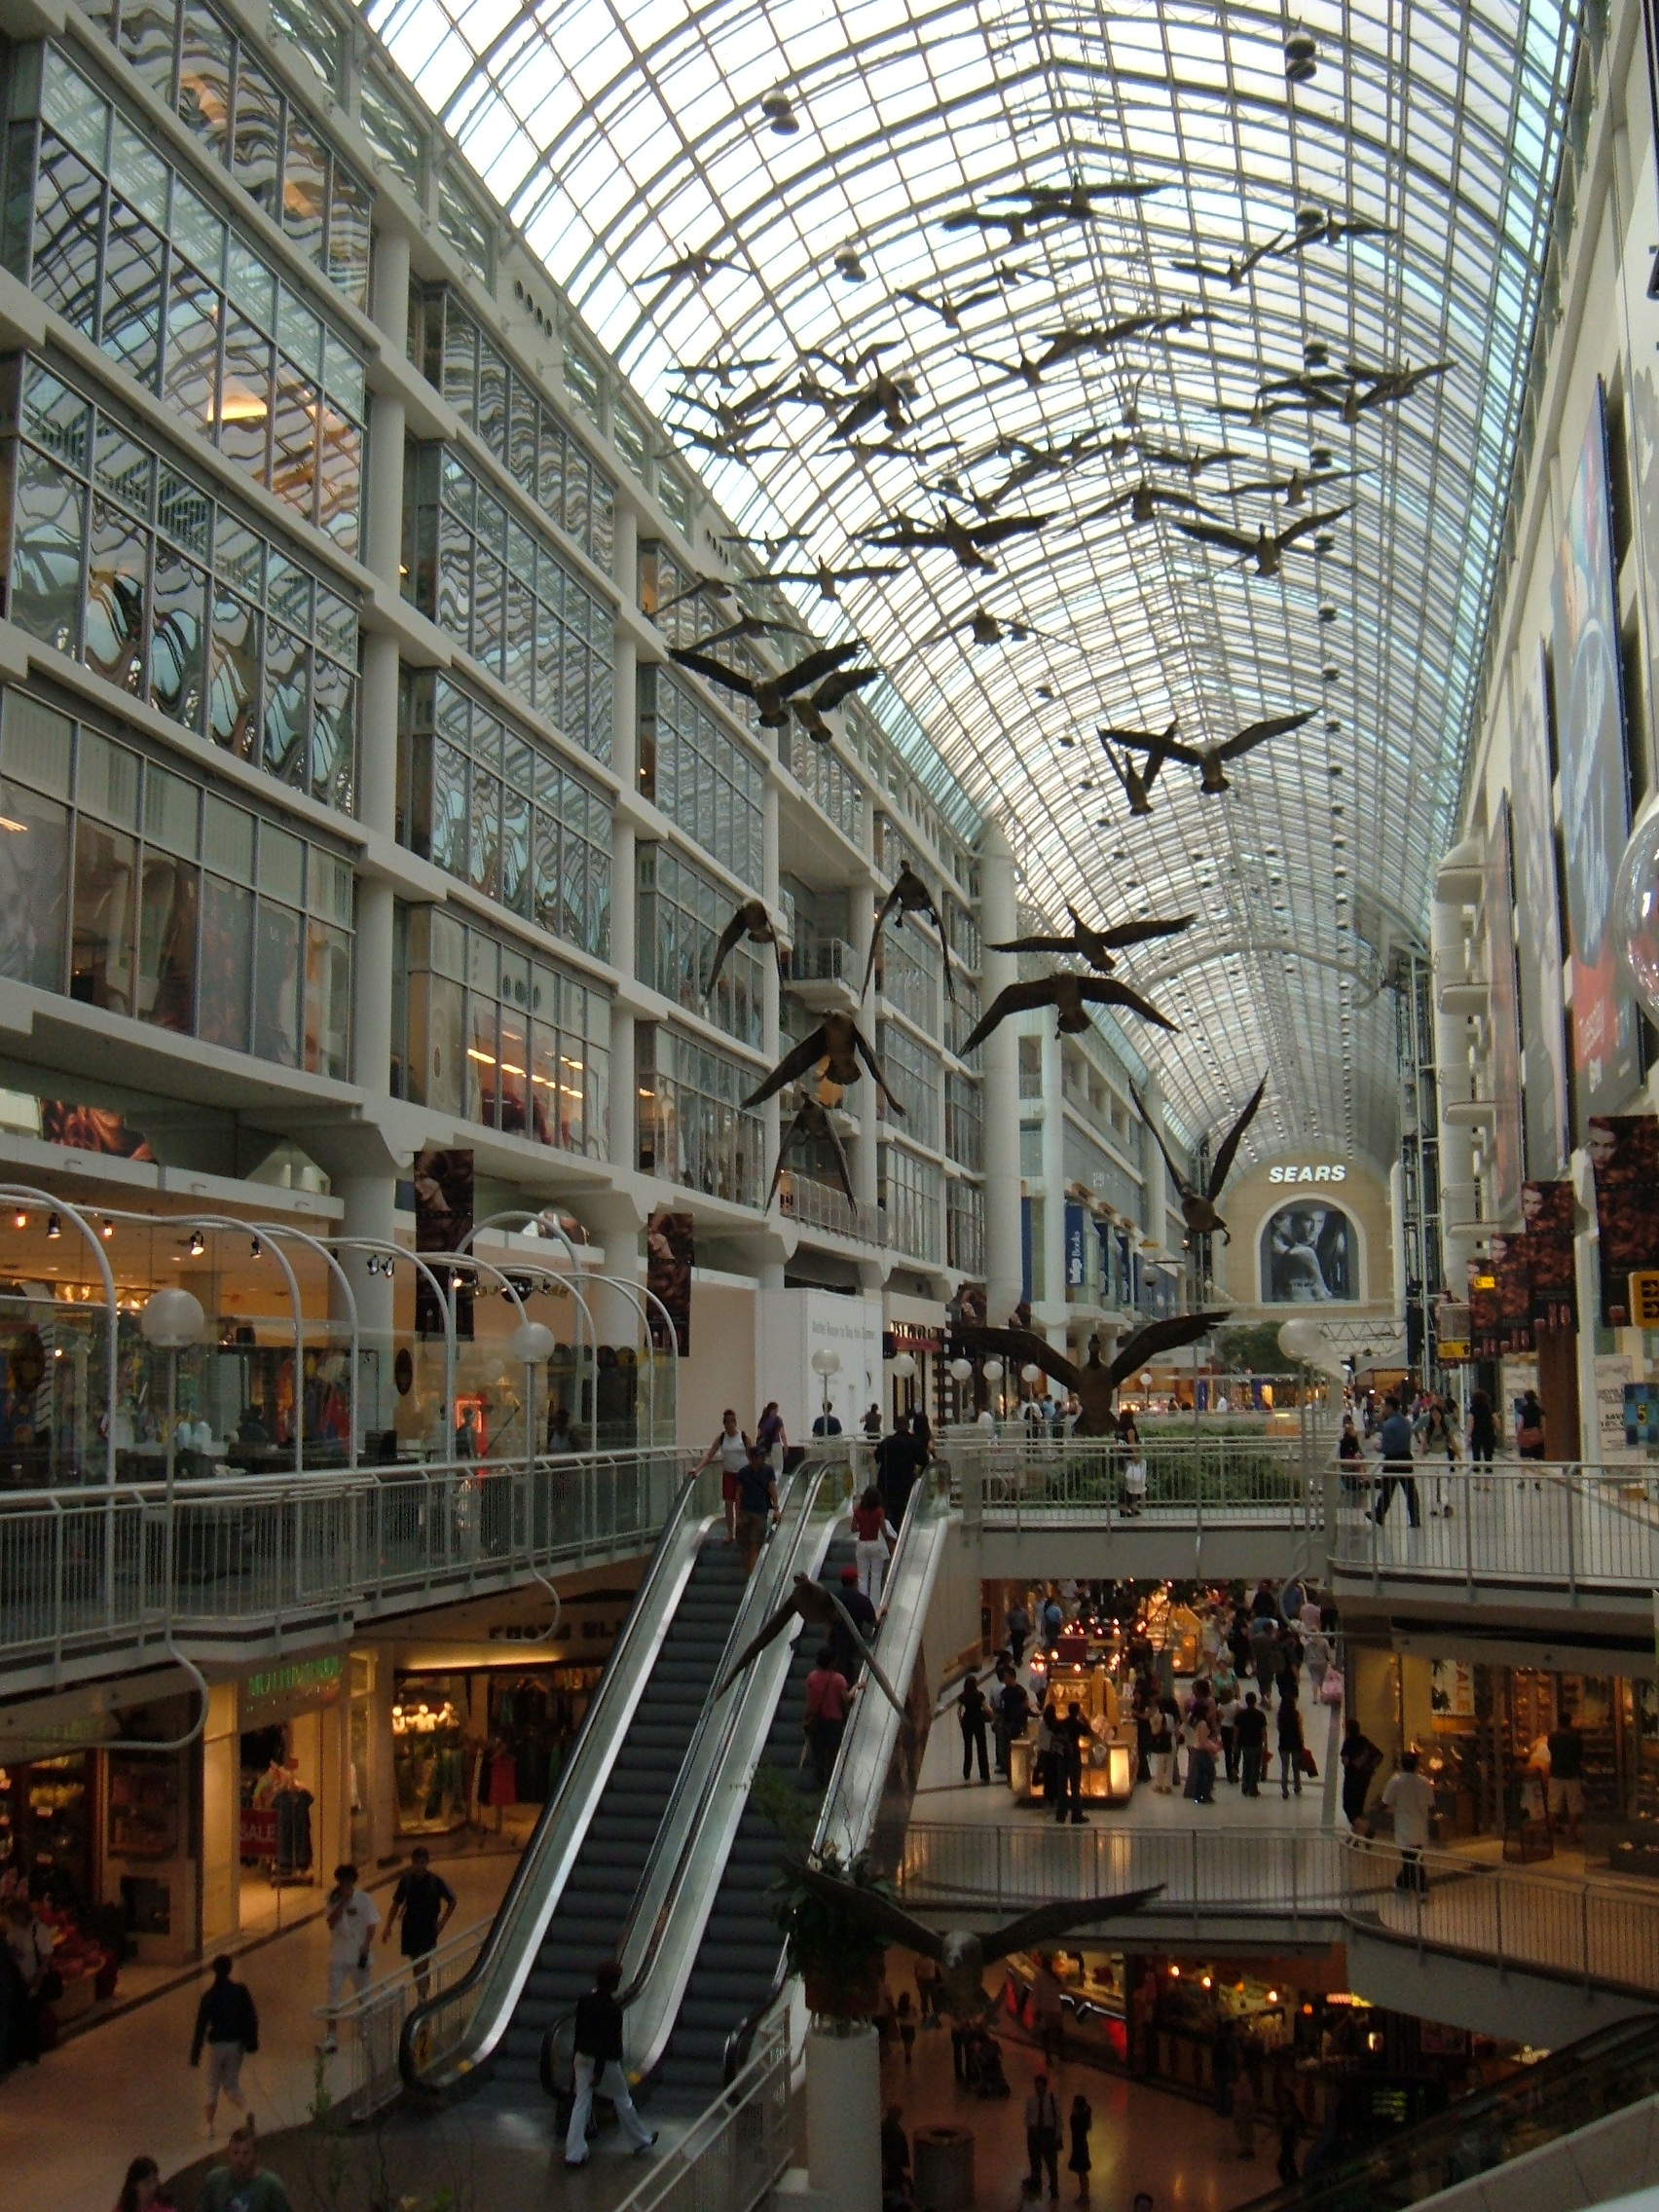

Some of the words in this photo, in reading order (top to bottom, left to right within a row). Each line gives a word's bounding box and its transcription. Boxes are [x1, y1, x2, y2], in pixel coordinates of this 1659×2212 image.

[1269, 1164, 1346, 1184] SEARS
[1070, 1231, 1082, 1257] Books
[1456, 1660, 1471, 1713] SALE
[240, 1822, 276, 1843] SALE
